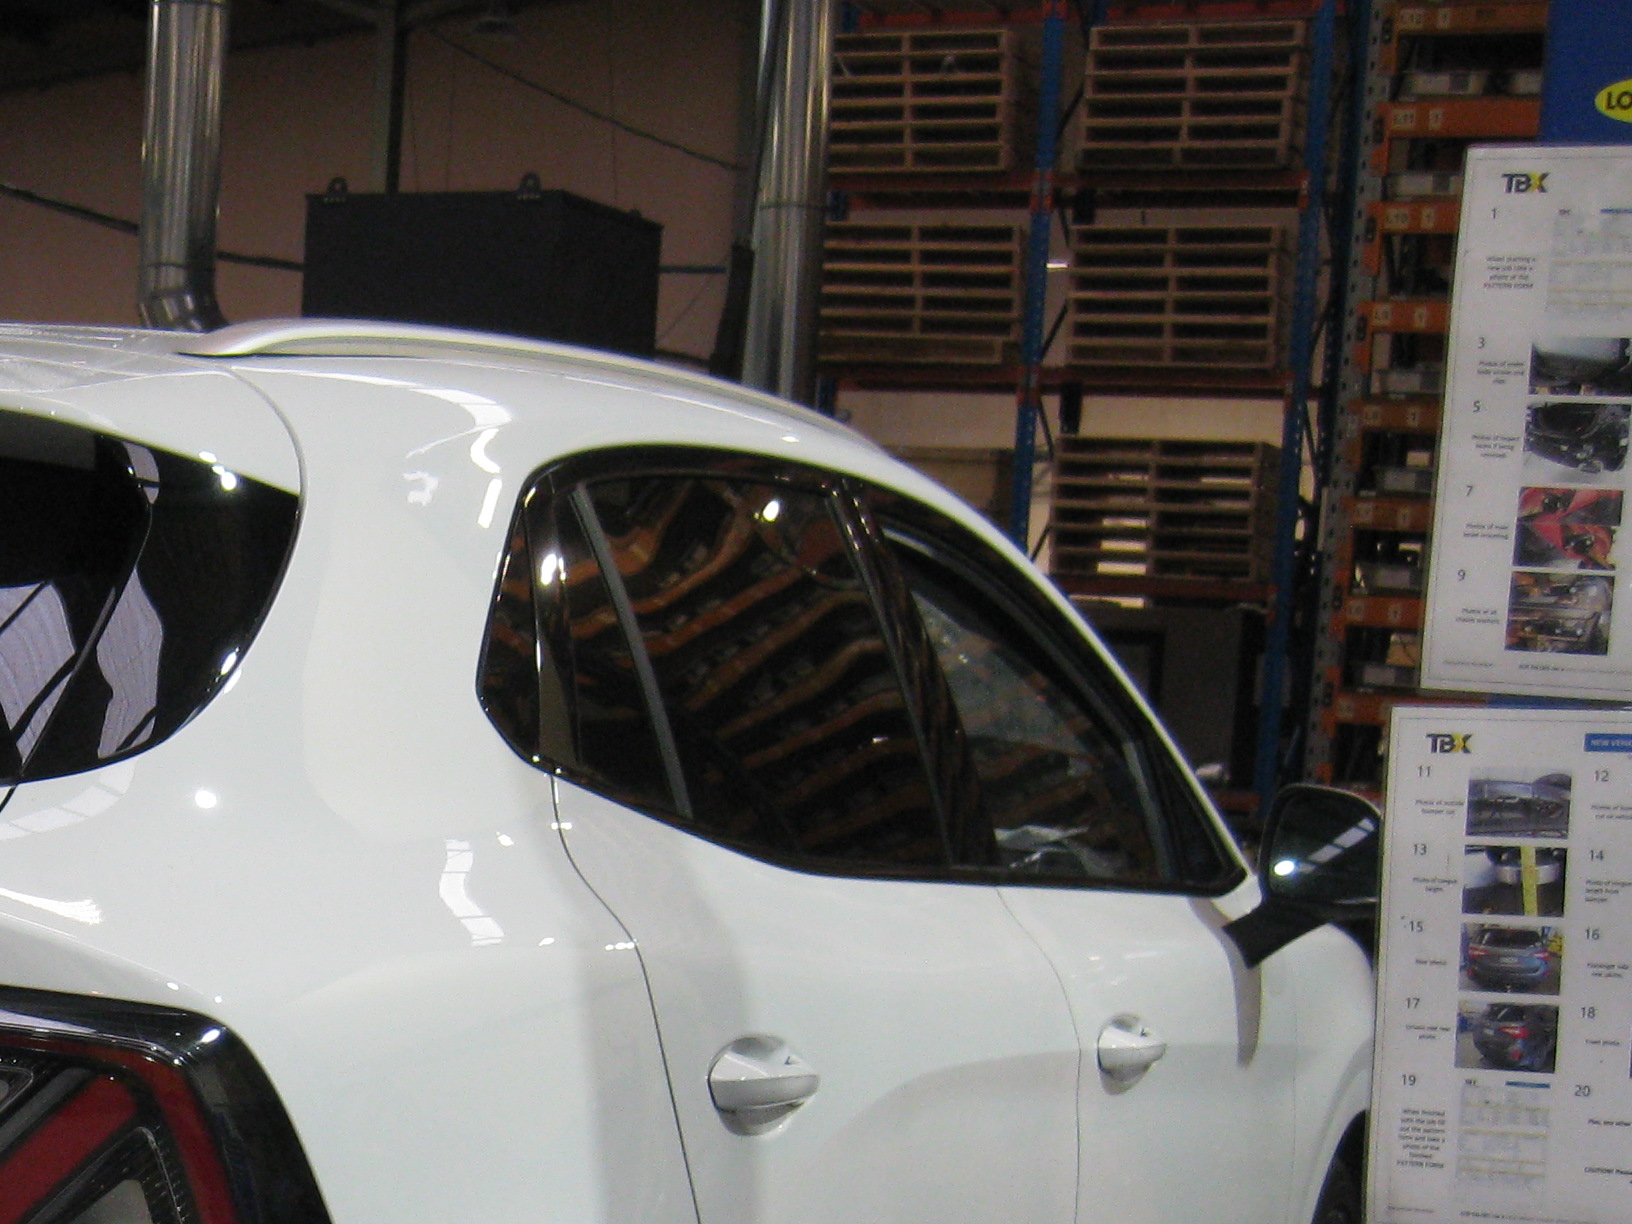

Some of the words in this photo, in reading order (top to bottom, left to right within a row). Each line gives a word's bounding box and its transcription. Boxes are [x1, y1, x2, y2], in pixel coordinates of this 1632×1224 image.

[1477, 337, 1485, 349] 3
[1473, 400, 1480, 413] 5
[1466, 485, 1473, 497] 7
[1457, 569, 1466, 582] 9
[1417, 765, 1432, 778] 11
[1594, 769, 1610, 782] 12
[1413, 843, 1427, 856] 13
[1589, 850, 1604, 862] 14
[1409, 920, 1424, 932] 15
[1585, 928, 1600, 941] 16
[1406, 997, 1421, 1009] 17
[1581, 1006, 1596, 1019] 18
[1402, 1074, 1416, 1086] 19
[1574, 1084, 1591, 1097] 20
